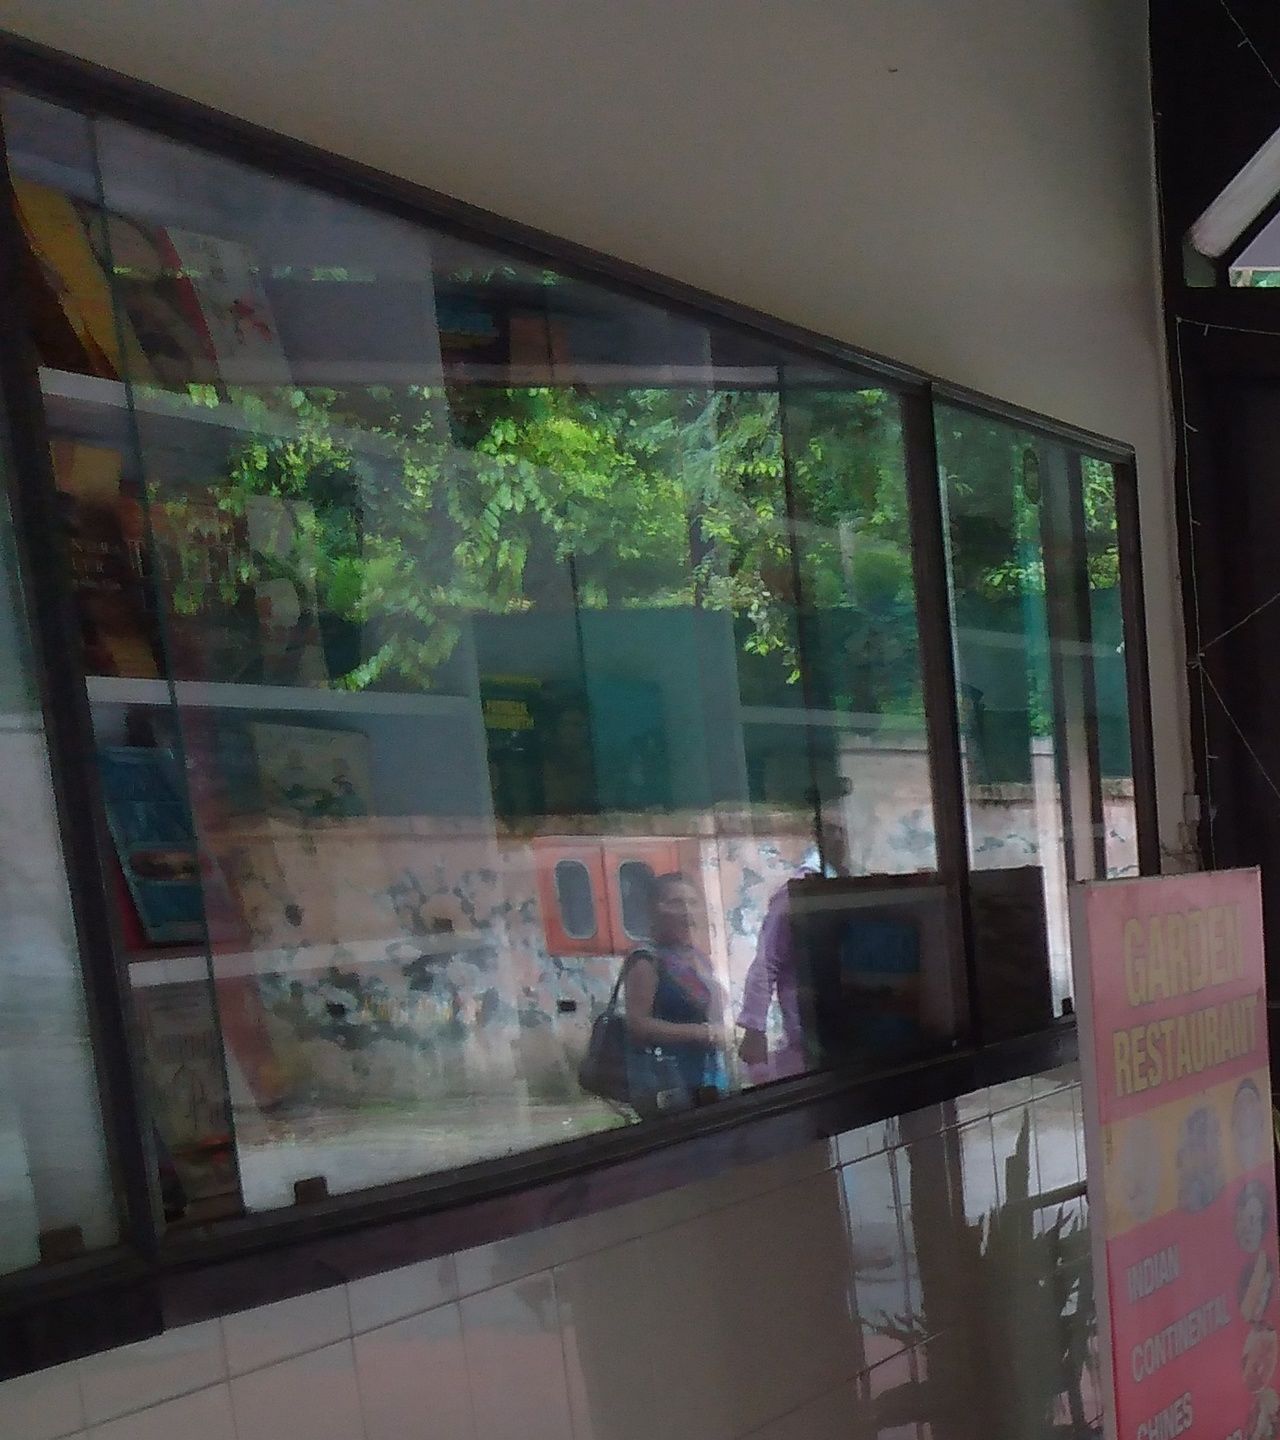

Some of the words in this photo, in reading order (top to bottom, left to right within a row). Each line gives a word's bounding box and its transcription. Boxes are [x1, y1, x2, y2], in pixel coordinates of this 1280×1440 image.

[1124, 906, 1244, 1006] GARDEN
[1113, 994, 1258, 1097] RESTAURANT
[1127, 1244, 1179, 1302] INDIAN
[1131, 1294, 1232, 1382] CONTINENTAL
